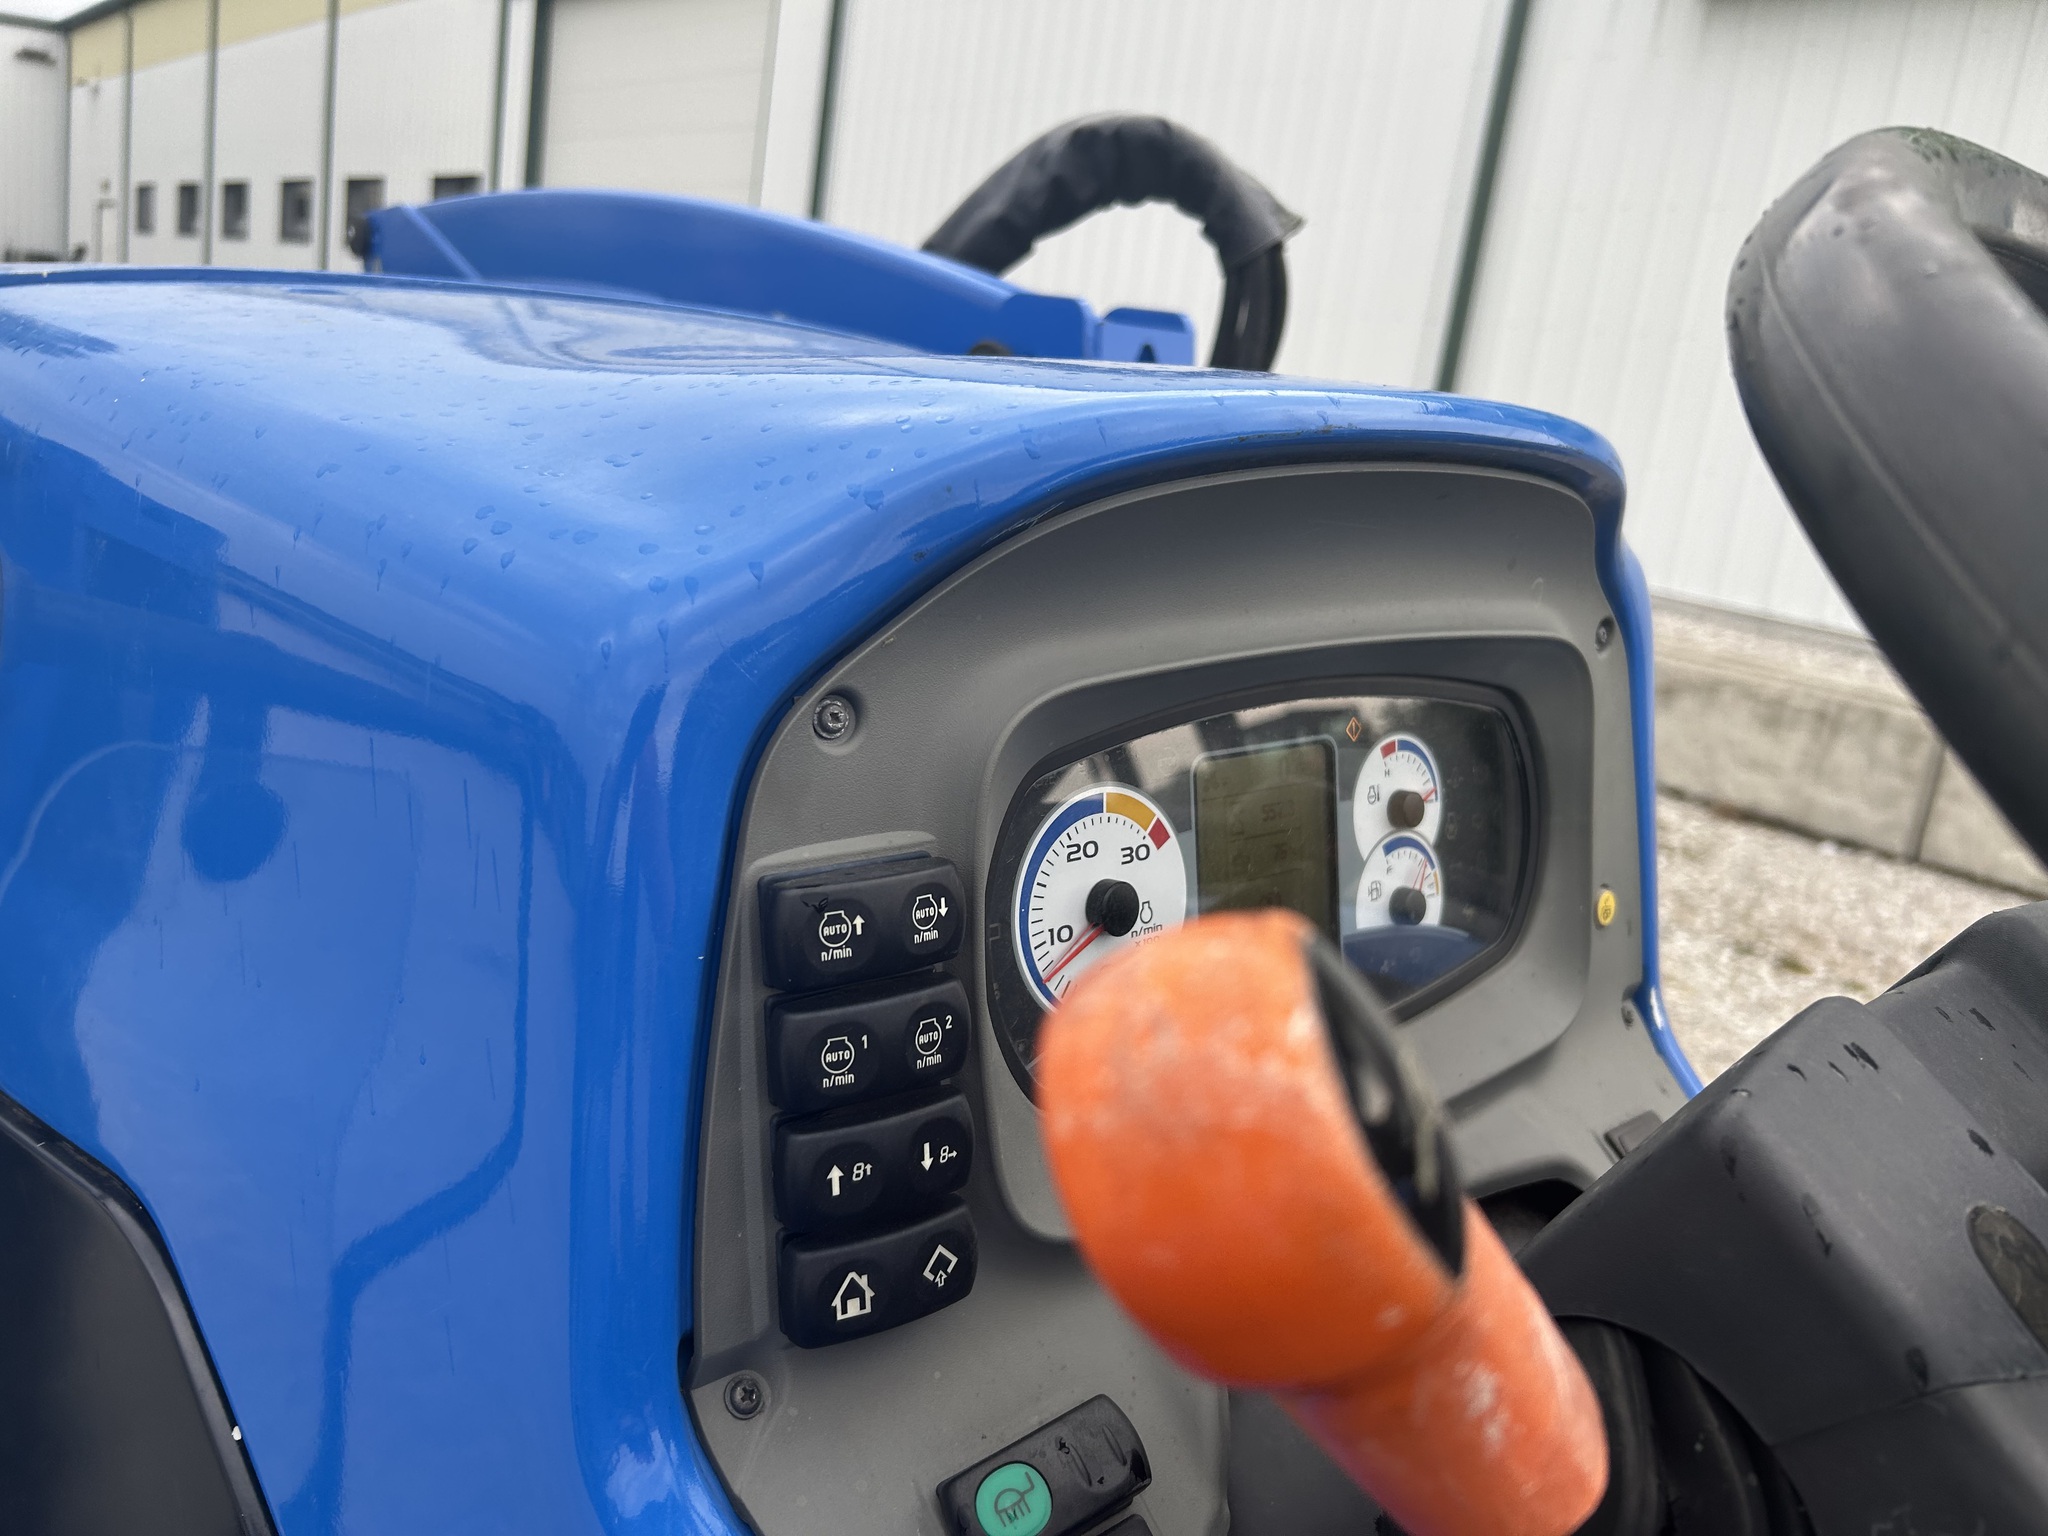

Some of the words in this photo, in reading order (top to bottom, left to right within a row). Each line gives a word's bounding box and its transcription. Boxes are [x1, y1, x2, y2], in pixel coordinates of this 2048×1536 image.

[1066, 840, 1099, 863] 20
[1120, 843, 1150, 865] 30
[915, 907, 935, 920] AUTO
[823, 924, 848, 936] AUTO
[914, 927, 939, 944] n/min
[1048, 925, 1074, 946] 10
[1130, 923, 1163, 938] n/min
[821, 945, 853, 962] n/min
[945, 1015, 953, 1030] 2
[861, 1034, 868, 1049] 1
[918, 1030, 939, 1044] AUTO
[825, 1050, 850, 1063] AUTO
[916, 1052, 942, 1070] n/min
[822, 1072, 855, 1088] n/min
